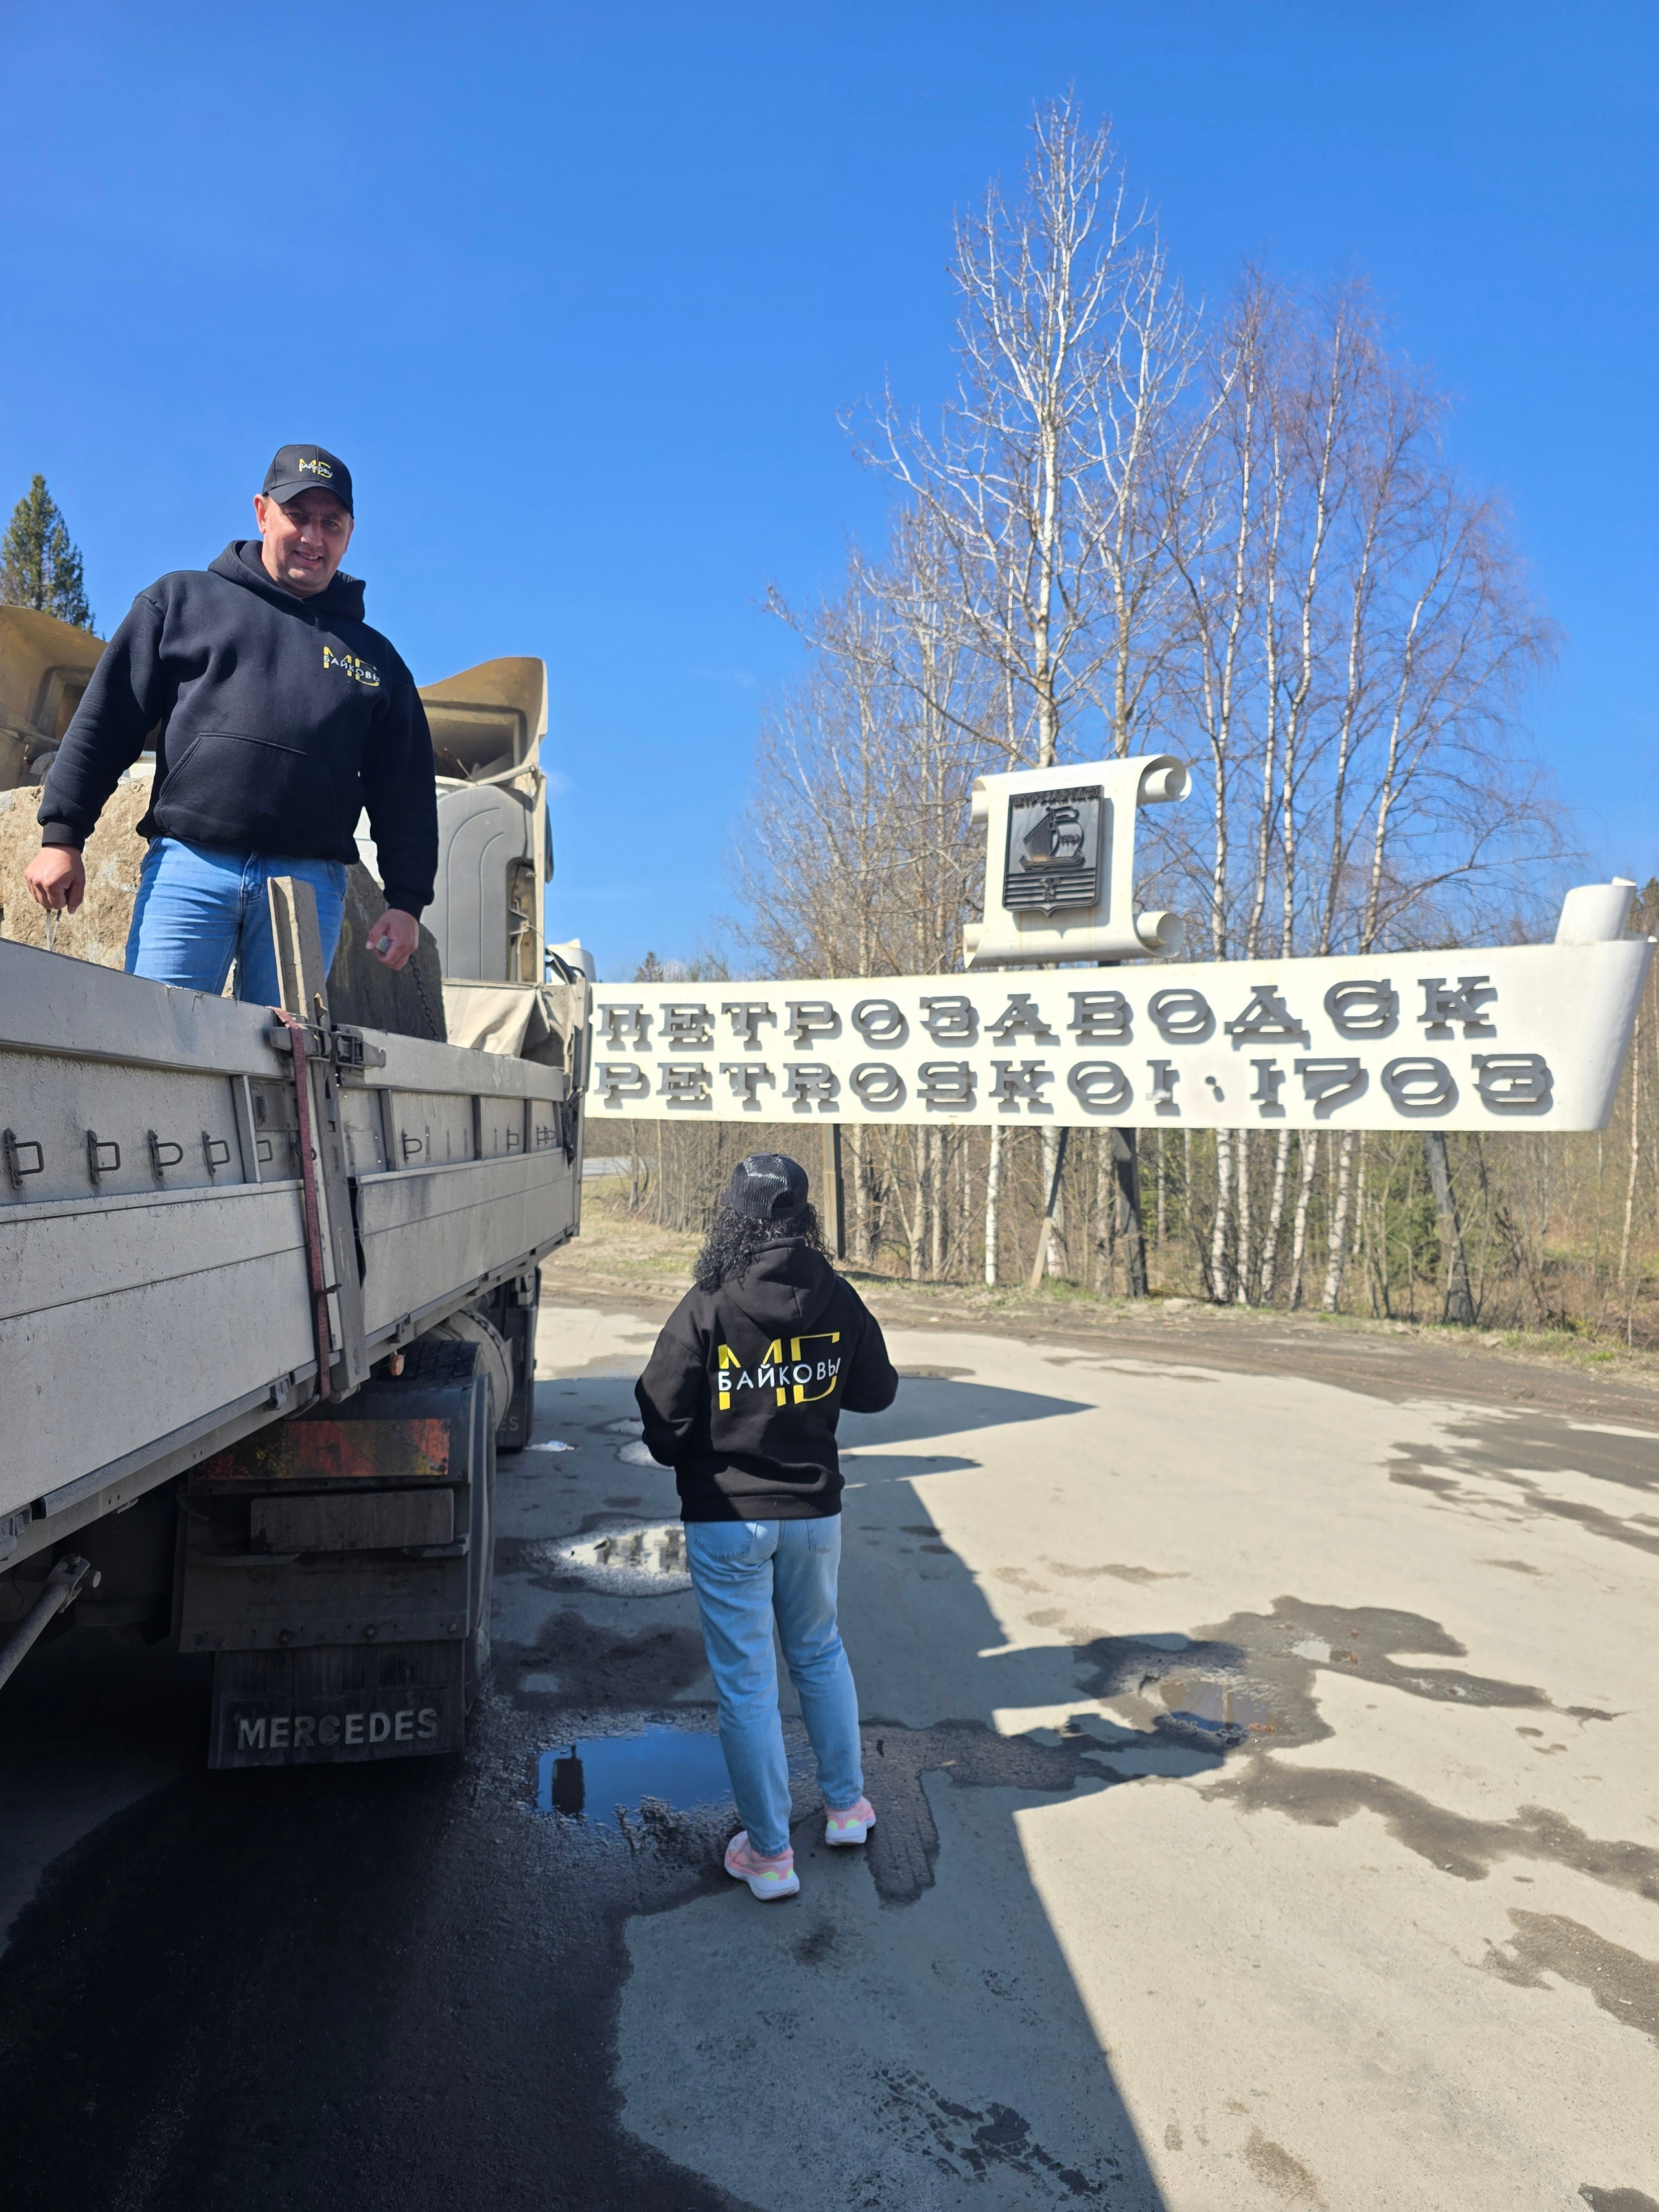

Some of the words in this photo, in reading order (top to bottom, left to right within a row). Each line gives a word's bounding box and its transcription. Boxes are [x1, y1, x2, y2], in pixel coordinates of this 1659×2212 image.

[596, 975, 1491, 1038] ПЕТРОЗАВОДСК
[594, 1059, 1172, 1101] PETROSKOI
[1249, 1053, 1550, 1102] 1703
[718, 1357, 841, 1391] БАЙКОВЫ
[237, 1707, 438, 1750] MERCEDES
